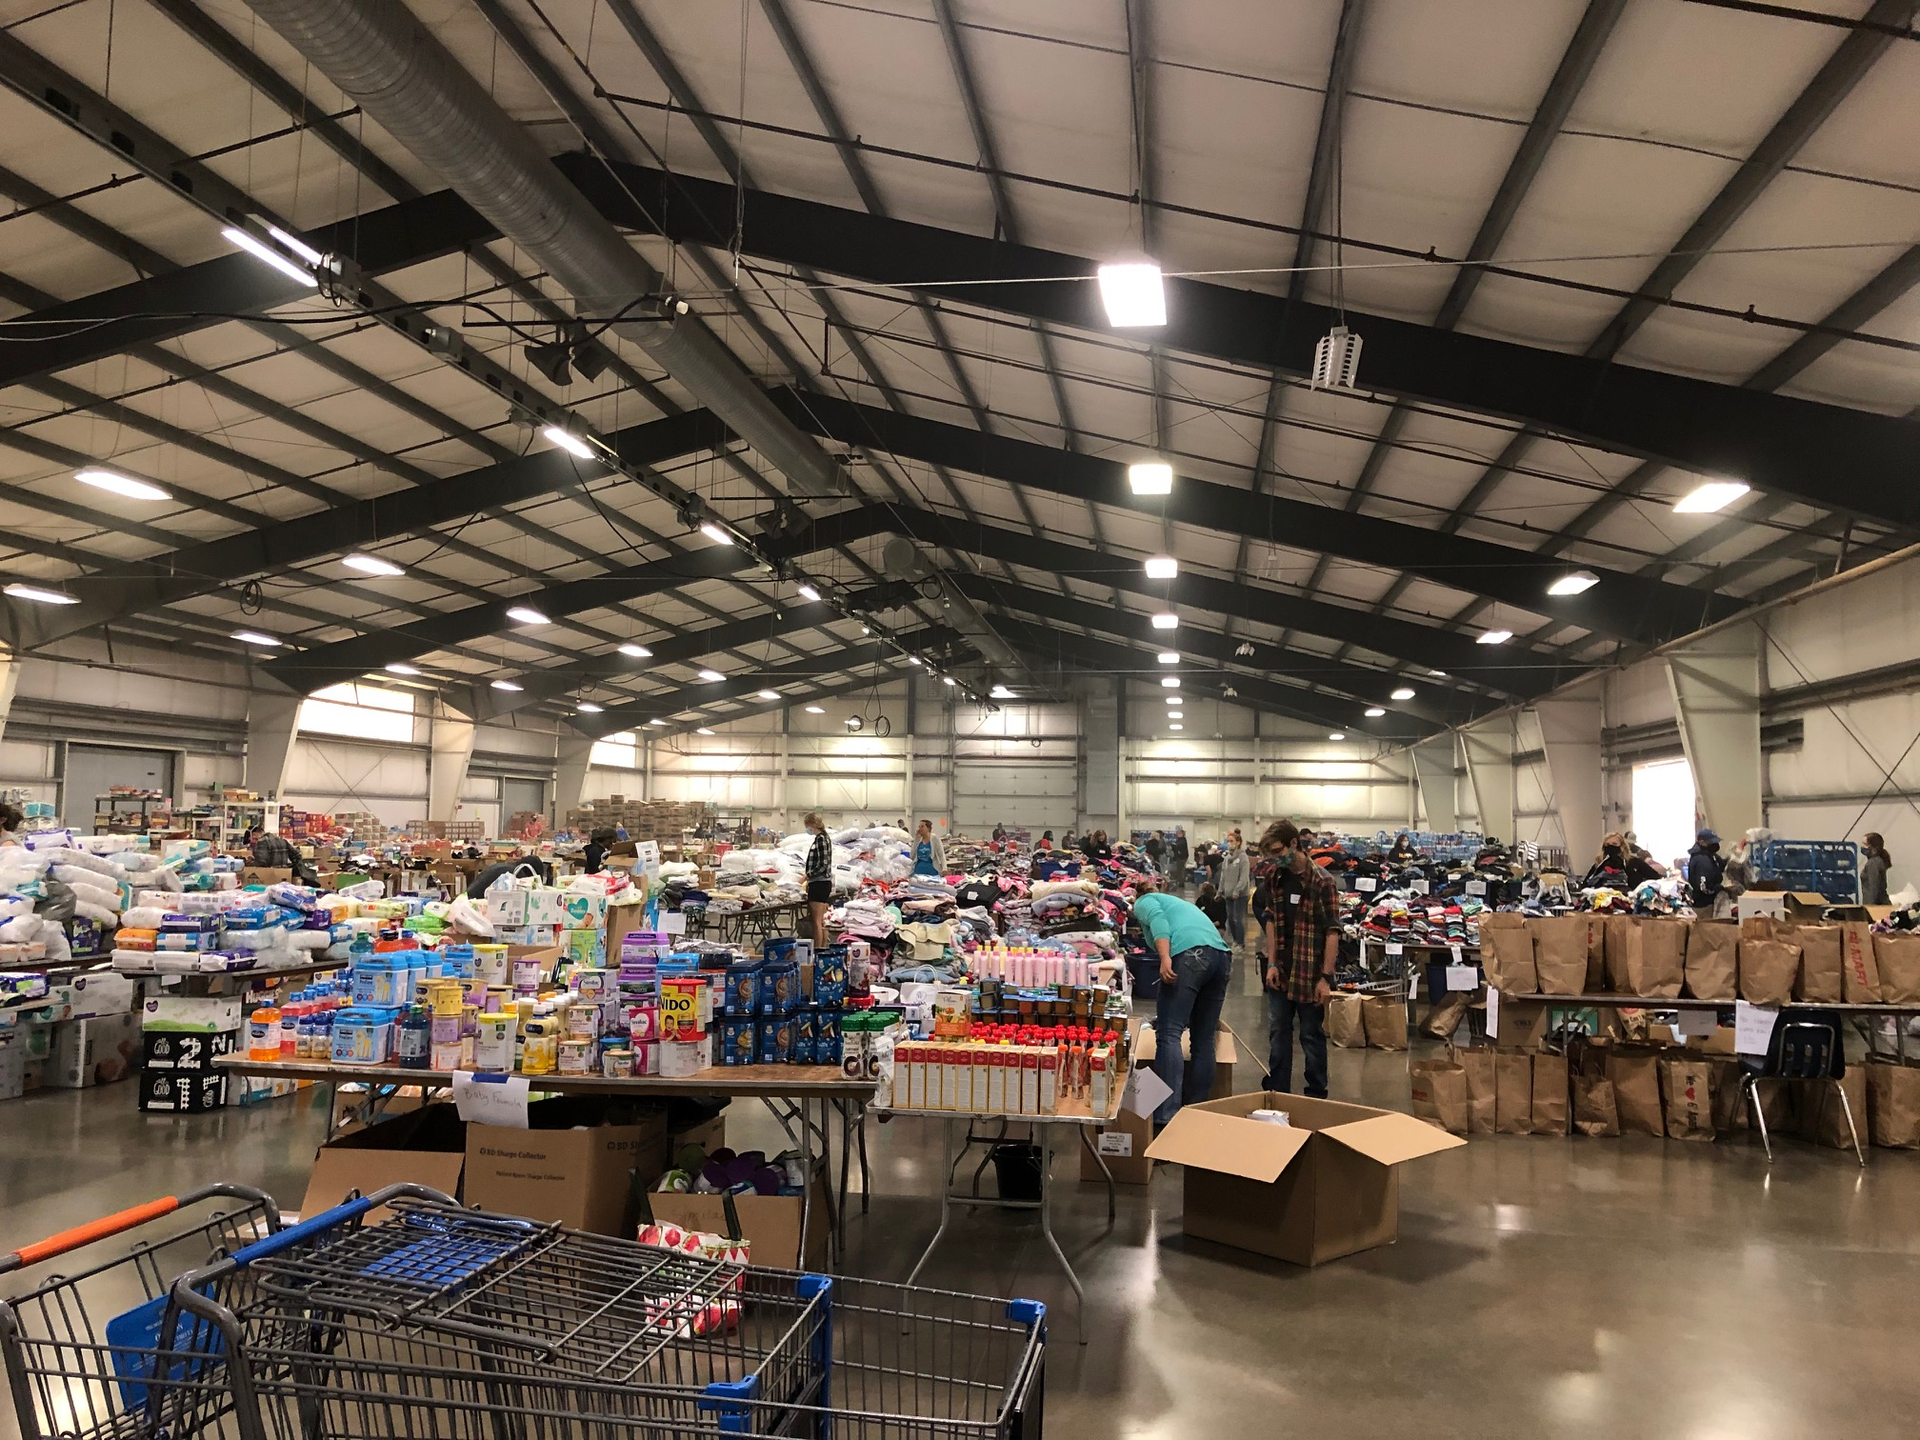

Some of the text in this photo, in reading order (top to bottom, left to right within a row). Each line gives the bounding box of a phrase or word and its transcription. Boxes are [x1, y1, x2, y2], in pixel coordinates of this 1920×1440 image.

[177, 1037, 202, 1069] 2
[463, 1087, 489, 1106] Baby
[497, 1149, 517, 1158] Sharps
[518, 1151, 546, 1160] Collector
